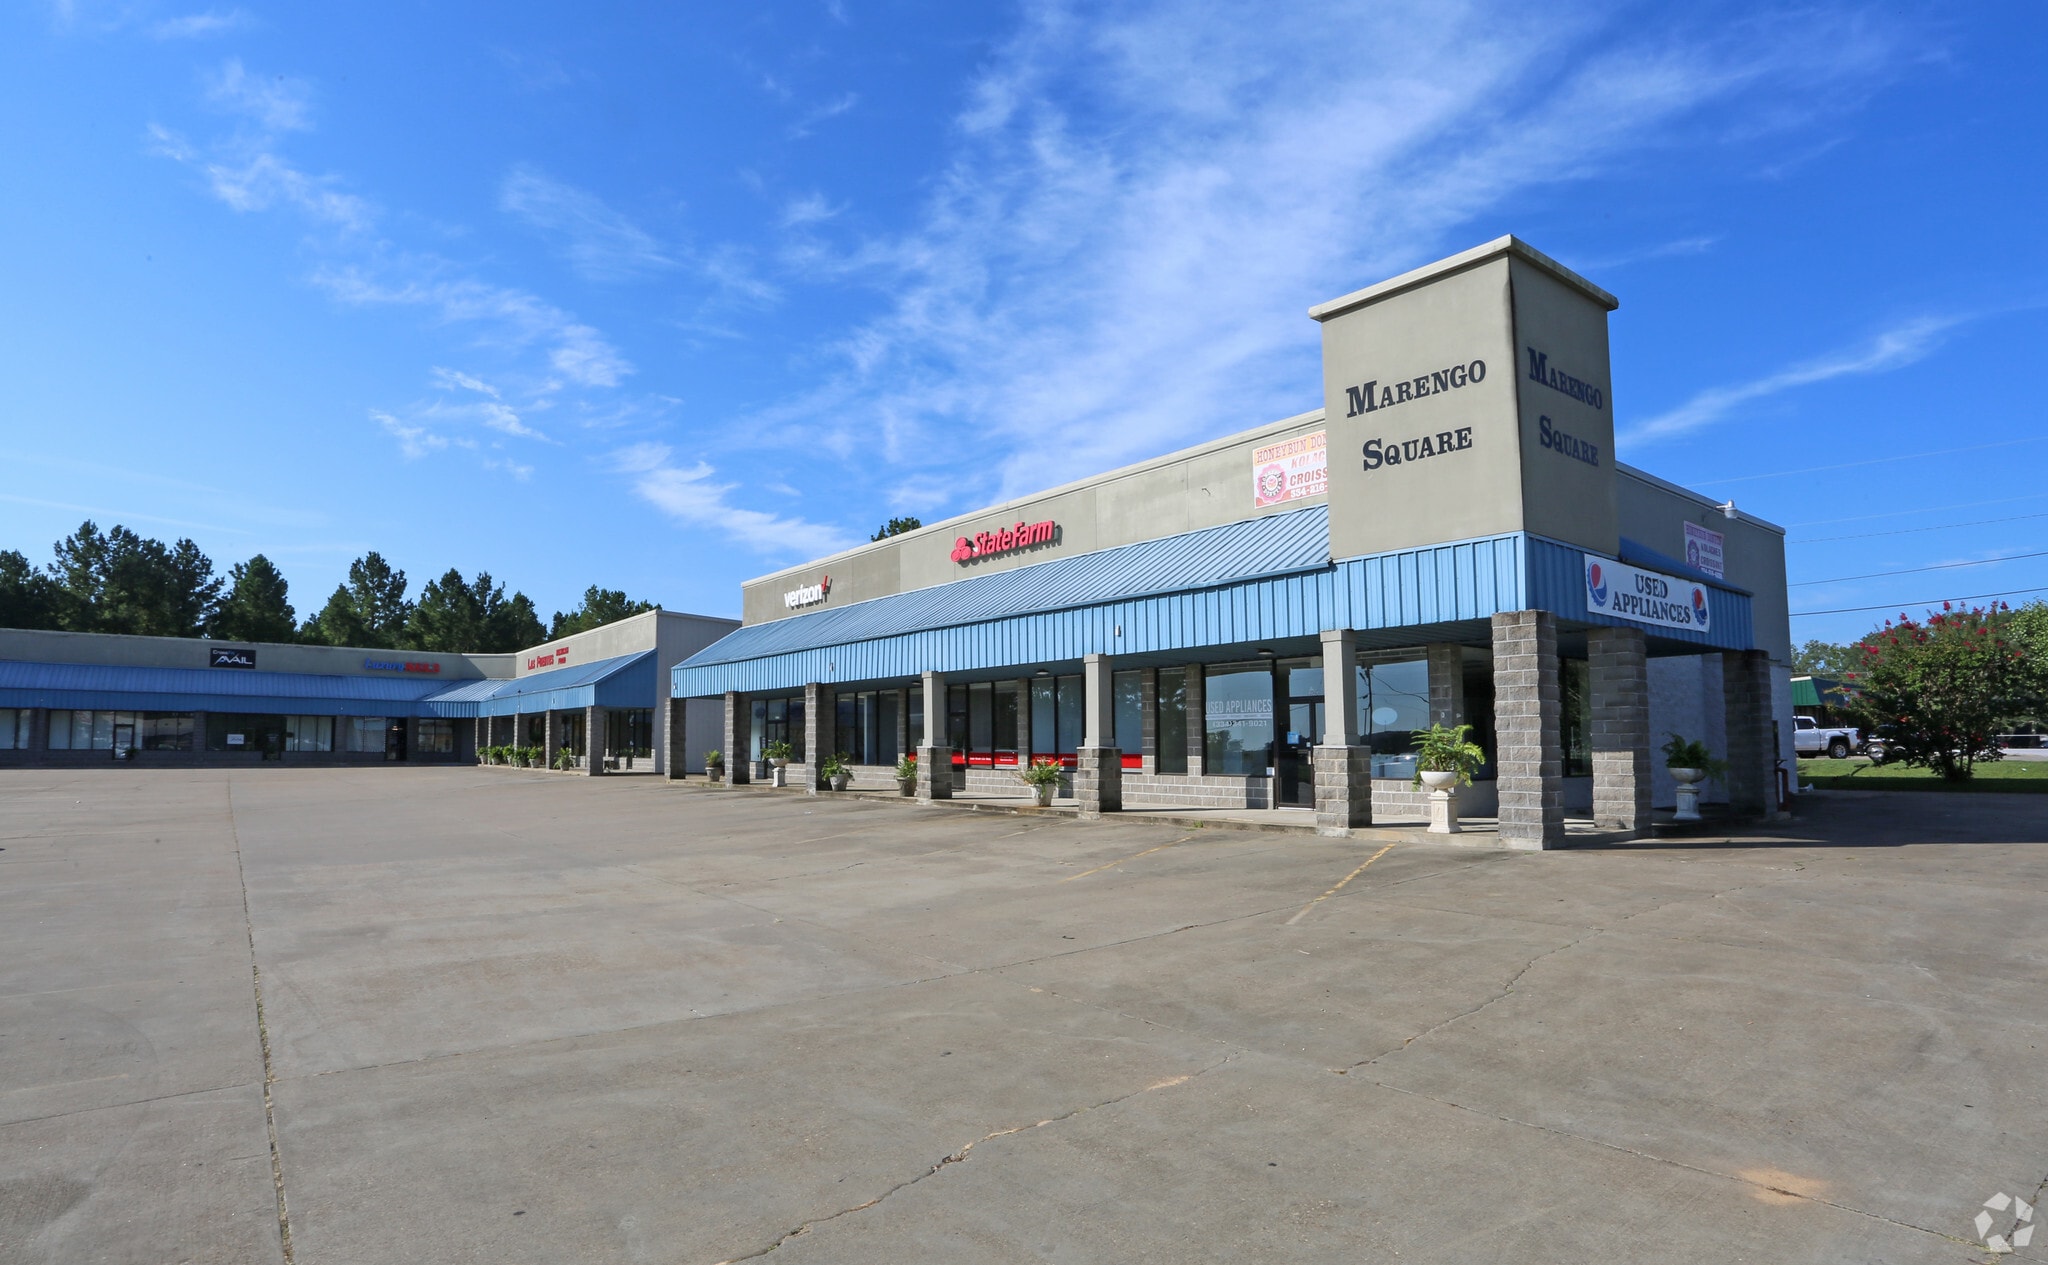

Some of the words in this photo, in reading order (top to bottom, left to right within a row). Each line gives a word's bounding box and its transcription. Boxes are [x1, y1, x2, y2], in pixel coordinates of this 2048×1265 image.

[1346, 360, 1486, 418] MARENGO
[1528, 347, 1603, 410] MARENGO
[1257, 439, 1307, 463] HONEYBUN
[1362, 427, 1473, 471] SQUARE
[1540, 415, 1599, 467] SQUARE
[784, 584, 822, 607] verizon
[1635, 574, 1668, 599] USED
[1612, 591, 1691, 624] APPLIANCES
[213, 654, 253, 665] AVAIL
[1226, 699, 1272, 713] APPLIANCES
